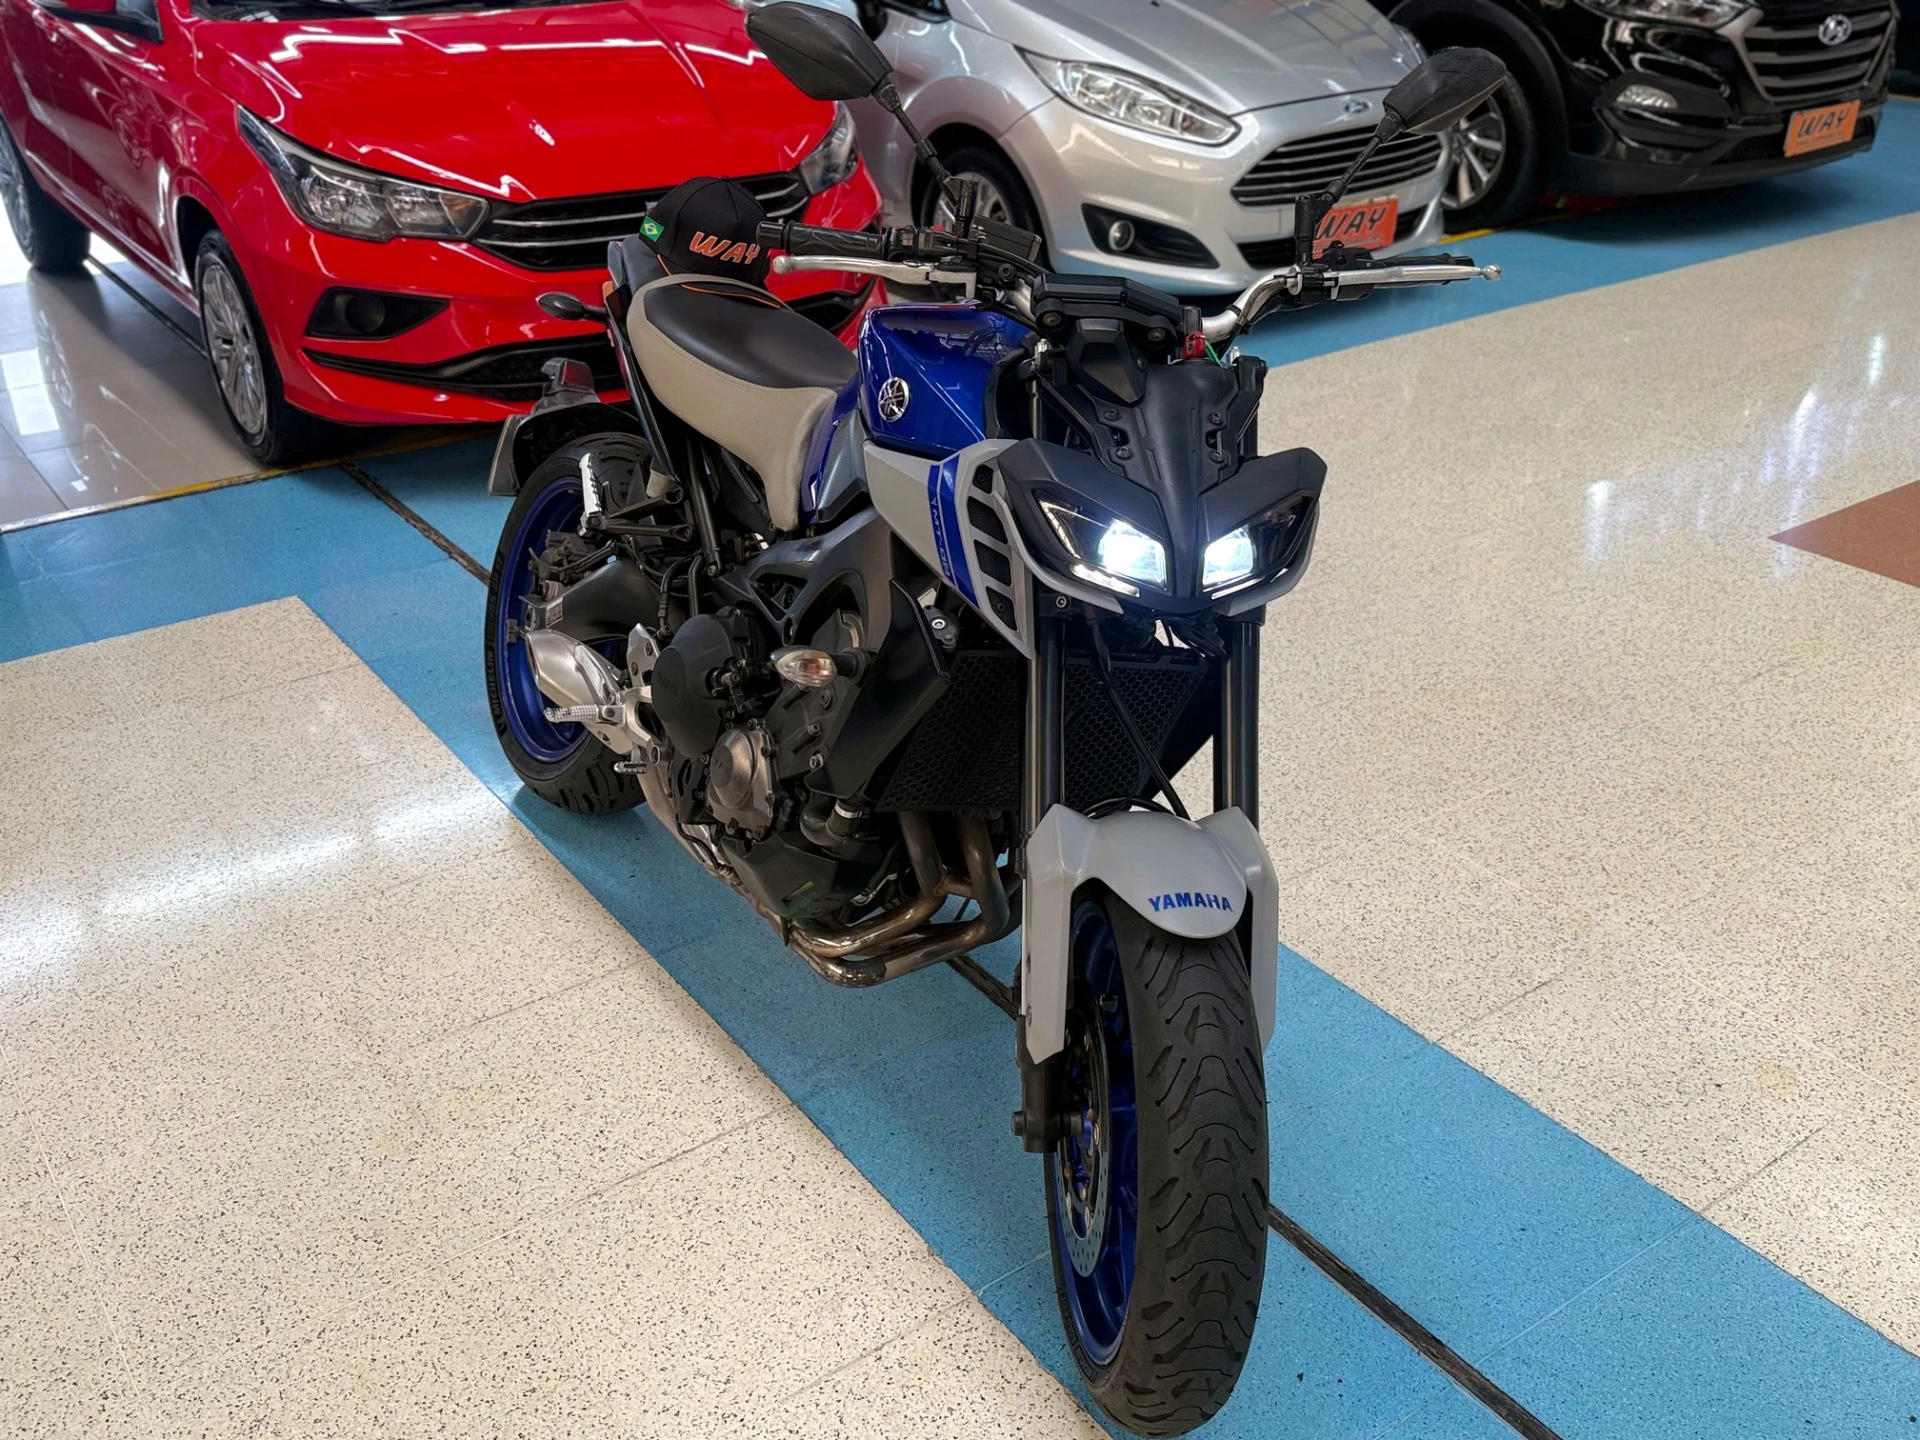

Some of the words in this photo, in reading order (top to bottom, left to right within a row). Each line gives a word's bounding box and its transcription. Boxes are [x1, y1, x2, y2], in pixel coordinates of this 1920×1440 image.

[1797, 107, 1851, 138] WAY
[689, 231, 761, 265] WAY
[486, 650, 501, 715] MICHELIN
[1148, 892, 1234, 912] YAMAHA
